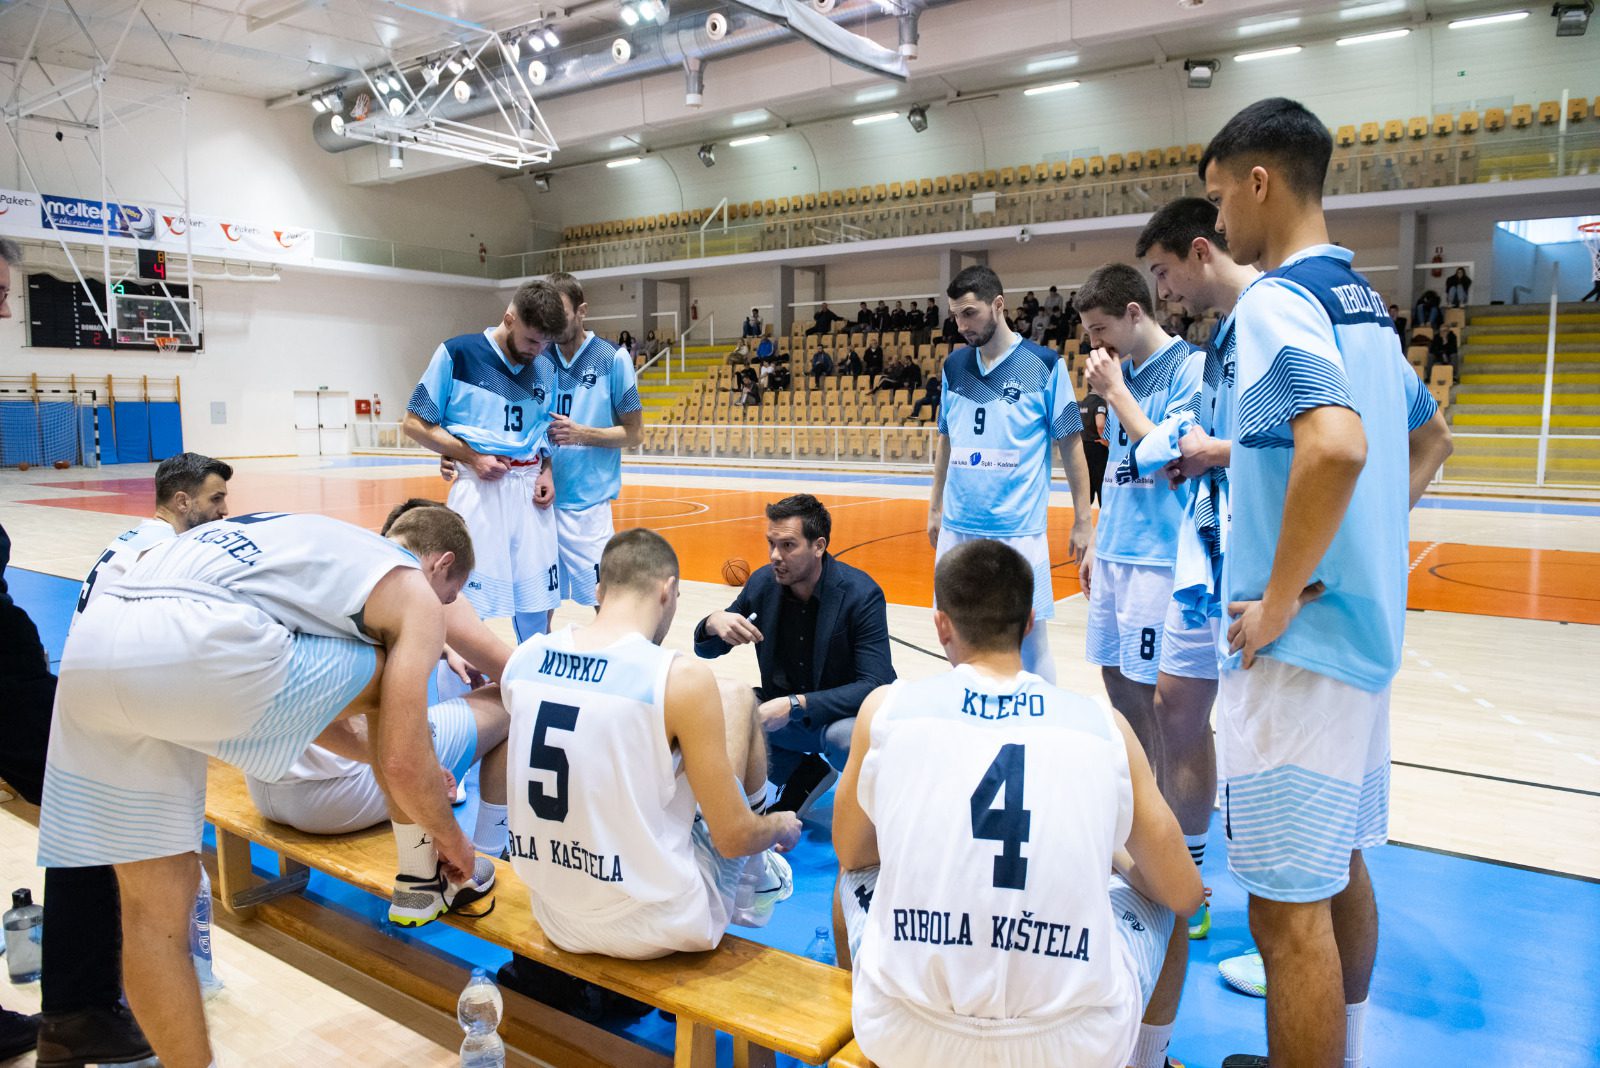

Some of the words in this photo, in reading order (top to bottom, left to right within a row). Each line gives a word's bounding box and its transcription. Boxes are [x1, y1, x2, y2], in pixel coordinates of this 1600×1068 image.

[47, 201, 111, 221] molten
[153, 264, 164, 278] 4
[504, 405, 523, 432] 13
[974, 408, 986, 435] 9
[548, 564, 559, 591] 13
[1140, 627, 1156, 660] 8
[538, 650, 608, 683] MURKO
[961, 688, 1045, 720] KLEPO
[528, 700, 580, 823] 5
[970, 743, 1031, 890] 4
[550, 840, 623, 882] KAŠTELA
[894, 908, 973, 946] RIBOLA
[991, 910, 1090, 962] KAŠTELA
